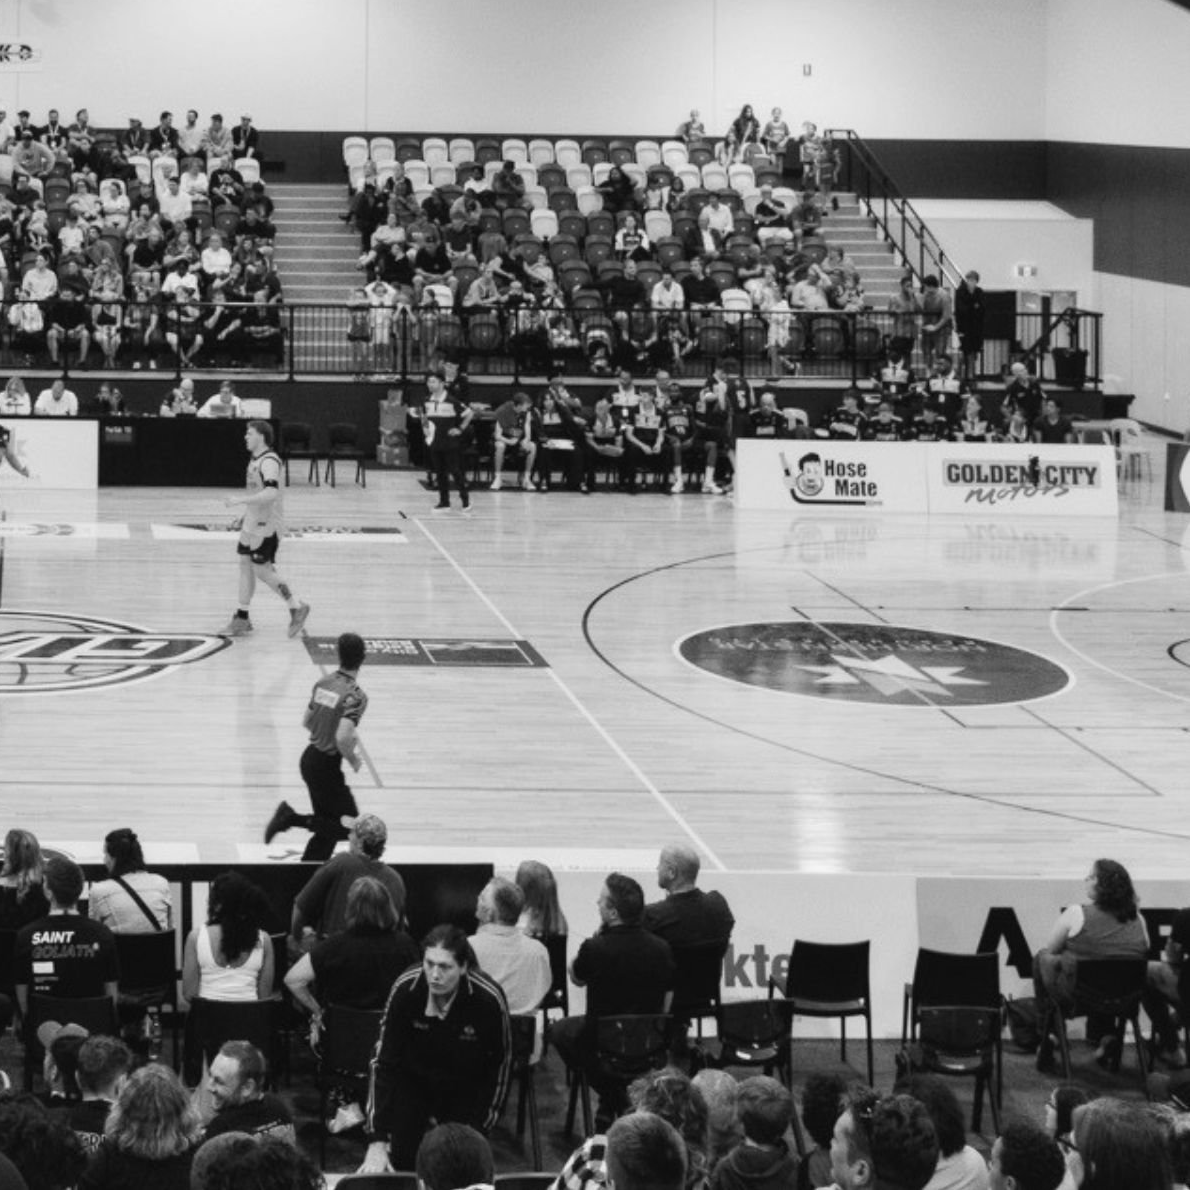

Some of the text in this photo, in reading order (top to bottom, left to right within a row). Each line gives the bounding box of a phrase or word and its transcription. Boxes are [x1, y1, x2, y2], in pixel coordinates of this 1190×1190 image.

[824, 460, 867, 477] Hose
[947, 463, 1097, 485] GOLDEN CITY
[834, 479, 878, 497] Mate
[31, 930, 75, 945] SAINT
